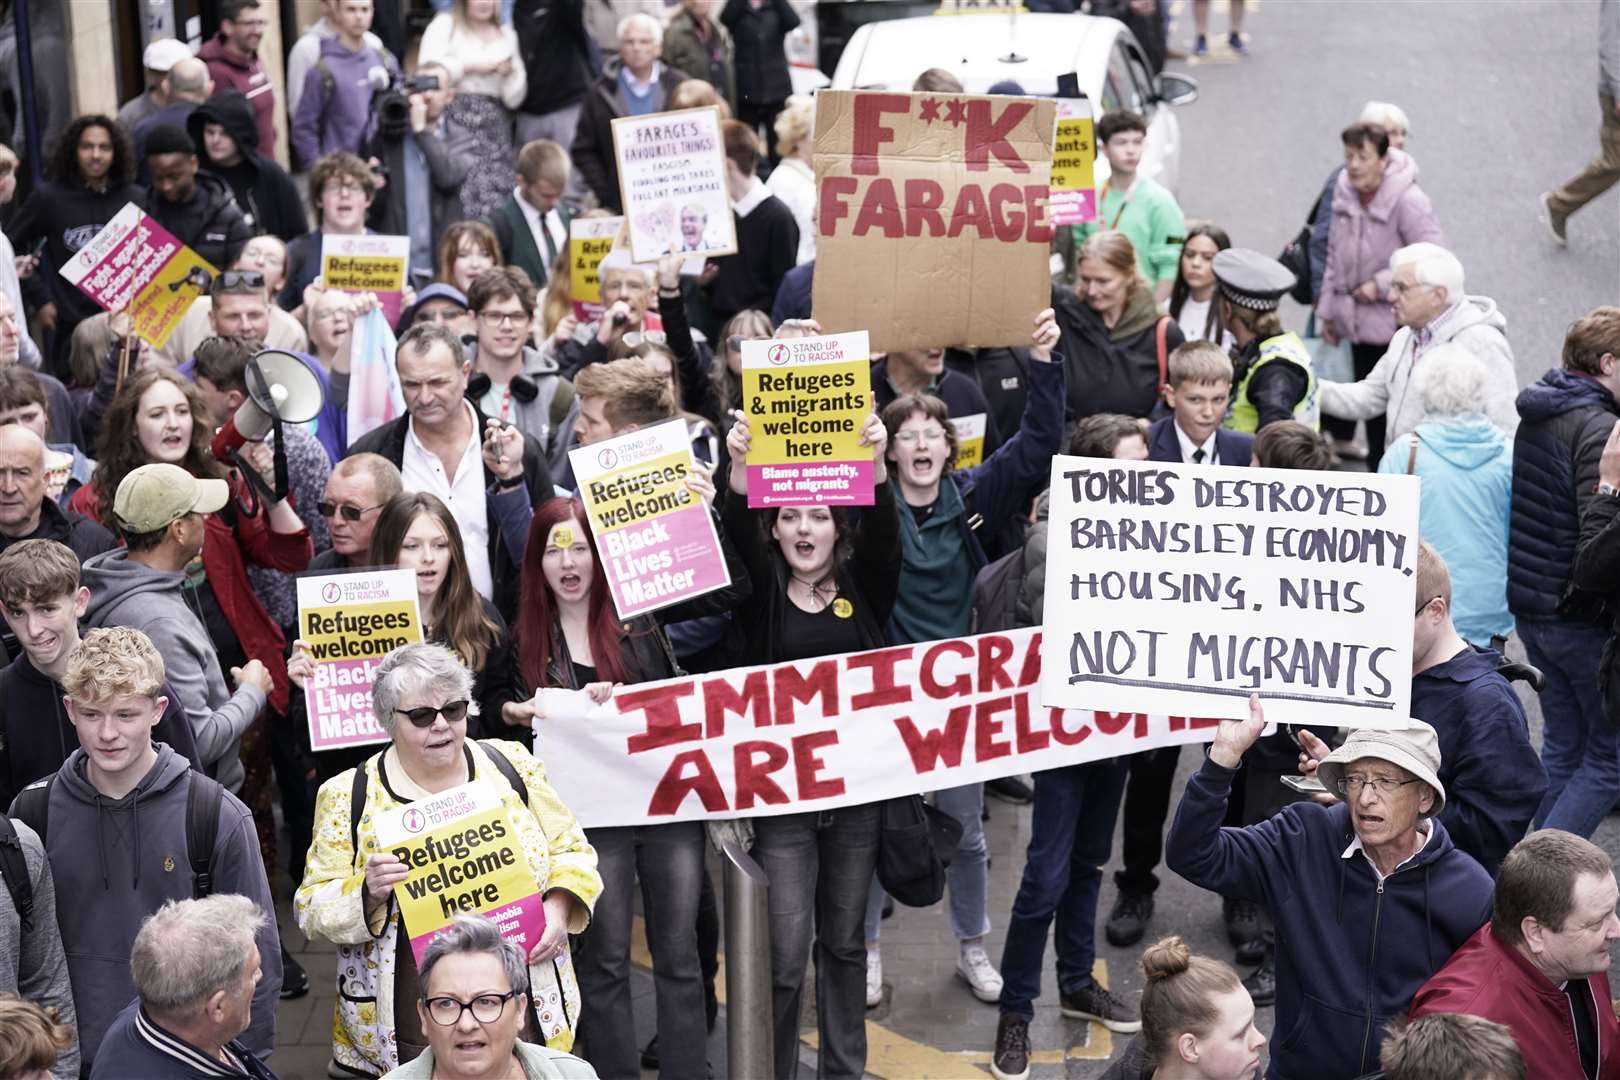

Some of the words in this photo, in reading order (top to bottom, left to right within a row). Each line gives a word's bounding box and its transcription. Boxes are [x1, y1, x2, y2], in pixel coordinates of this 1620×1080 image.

[636, 122, 699, 142] FARAGE'S
[625, 143, 677, 160] FAVOURITE
[819, 176, 1050, 243] FARAGE
[329, 258, 399, 275] Refugees
[328, 274, 394, 287] welcome
[793, 342, 823, 353] STAND
[825, 340, 838, 350] UP
[794, 354, 806, 363] TO
[808, 350, 843, 361] RACISM
[758, 372, 855, 394] Refugees
[751, 396, 766, 415] &
[771, 392, 865, 417] migrants
[763, 417, 854, 436] welcome
[617, 440, 644, 454] STAND
[786, 439, 833, 457] here
[589, 463, 687, 504] Refugees
[762, 467, 799, 479] Blame
[772, 479, 793, 491] not
[795, 478, 849, 493] migrants
[1063, 468, 1180, 506] TORIES
[1192, 477, 1386, 516] DESTROYED
[598, 489, 691, 528] welcome
[604, 519, 671, 557] Black
[1070, 518, 1255, 556] BARNSLEY
[612, 549, 673, 582] Lives
[344, 581, 369, 591] STAND
[372, 580, 384, 589] UP
[344, 592, 355, 601] TO
[357, 589, 389, 600] RACISM
[620, 567, 695, 607] Matter
[1279, 577, 1365, 613] NHS
[307, 611, 410, 636] Refugees
[313, 660, 378, 689] Black
[1069, 630, 1168, 676] NOT
[1187, 632, 1396, 698] MIGRANTS
[647, 729, 846, 816] ARE
[424, 797, 455, 815] STAND
[456, 792, 468, 805] UP
[428, 813, 442, 825] TO
[442, 801, 477, 820] RACISM
[392, 819, 506, 870] Refugees
[404, 846, 516, 900] welcome
[438, 883, 500, 919] here
